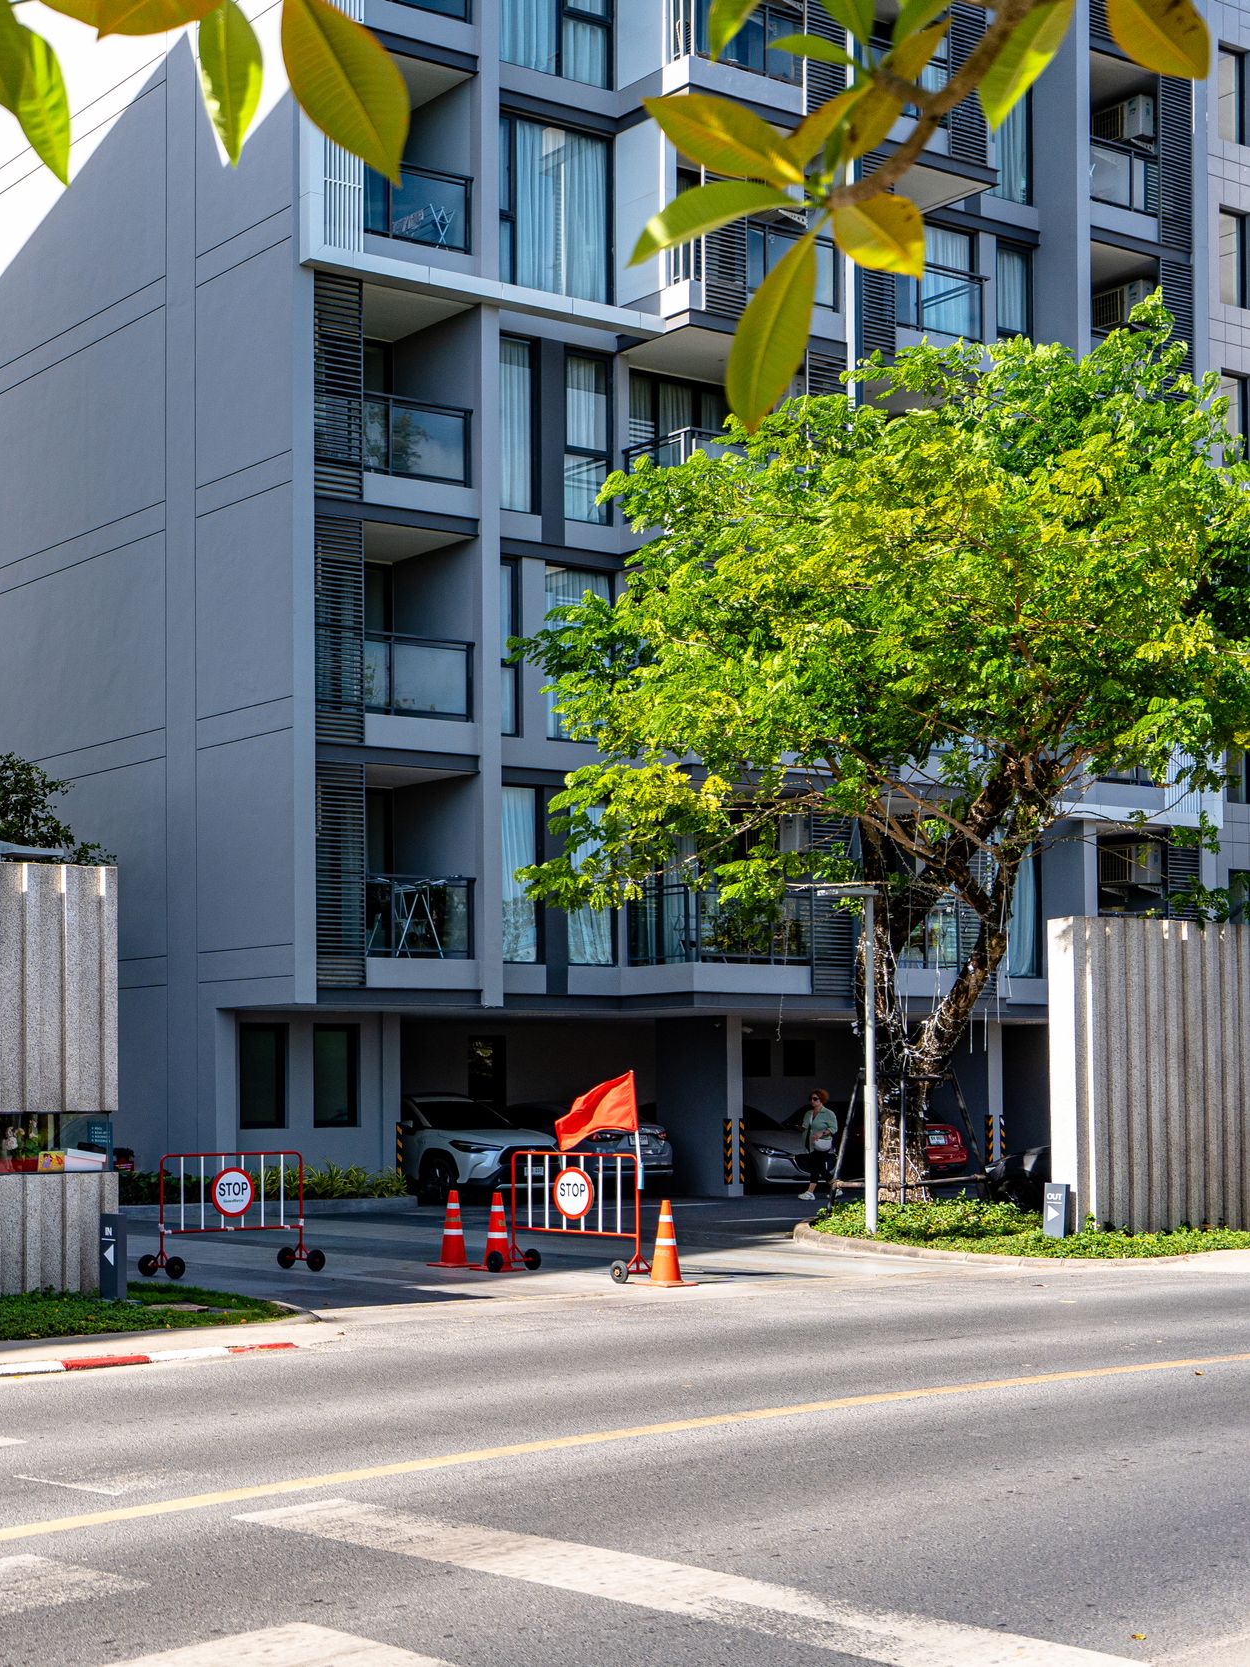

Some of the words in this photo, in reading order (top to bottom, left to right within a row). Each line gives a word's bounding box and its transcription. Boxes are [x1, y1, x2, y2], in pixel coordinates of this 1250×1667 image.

[218, 1182, 249, 1197] STOP
[559, 1182, 586, 1198] STOP
[1046, 1192, 1063, 1201] OUT
[104, 1226, 113, 1236] IN
